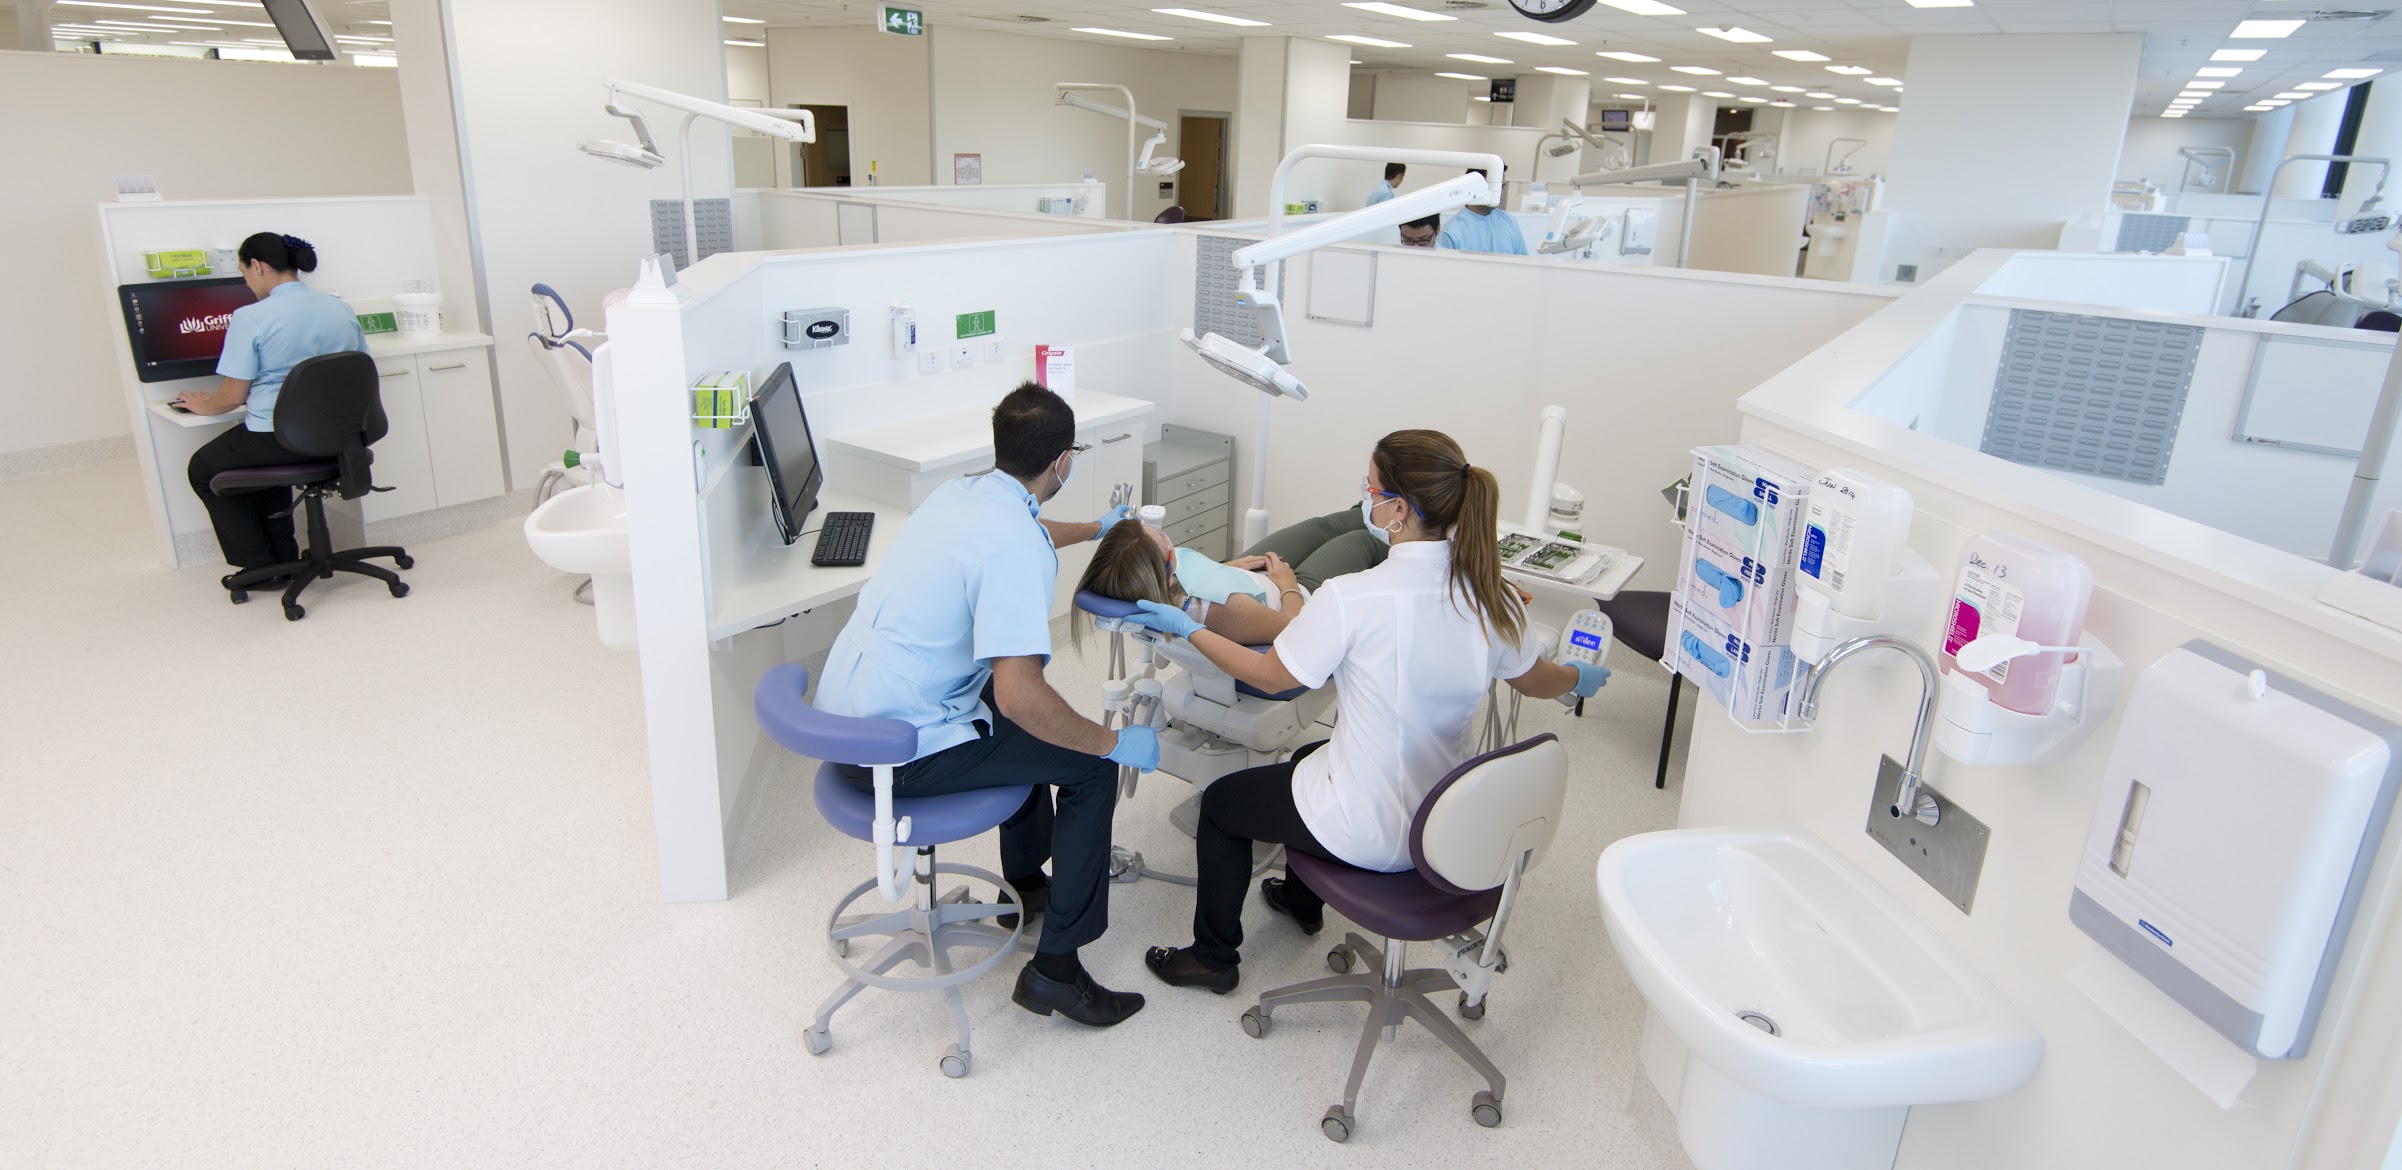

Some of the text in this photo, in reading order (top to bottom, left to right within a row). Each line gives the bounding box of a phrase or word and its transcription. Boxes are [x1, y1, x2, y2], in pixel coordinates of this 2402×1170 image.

[204, 314, 232, 325] Griff
[206, 323, 229, 331] UNIVE
[1718, 464, 1740, 478] Examination
[1741, 475, 1754, 484] Gloves
[1691, 506, 1718, 524] prmed.
[1994, 564, 2007, 578] 13
[1948, 599, 1961, 642] MICROSHIELD
